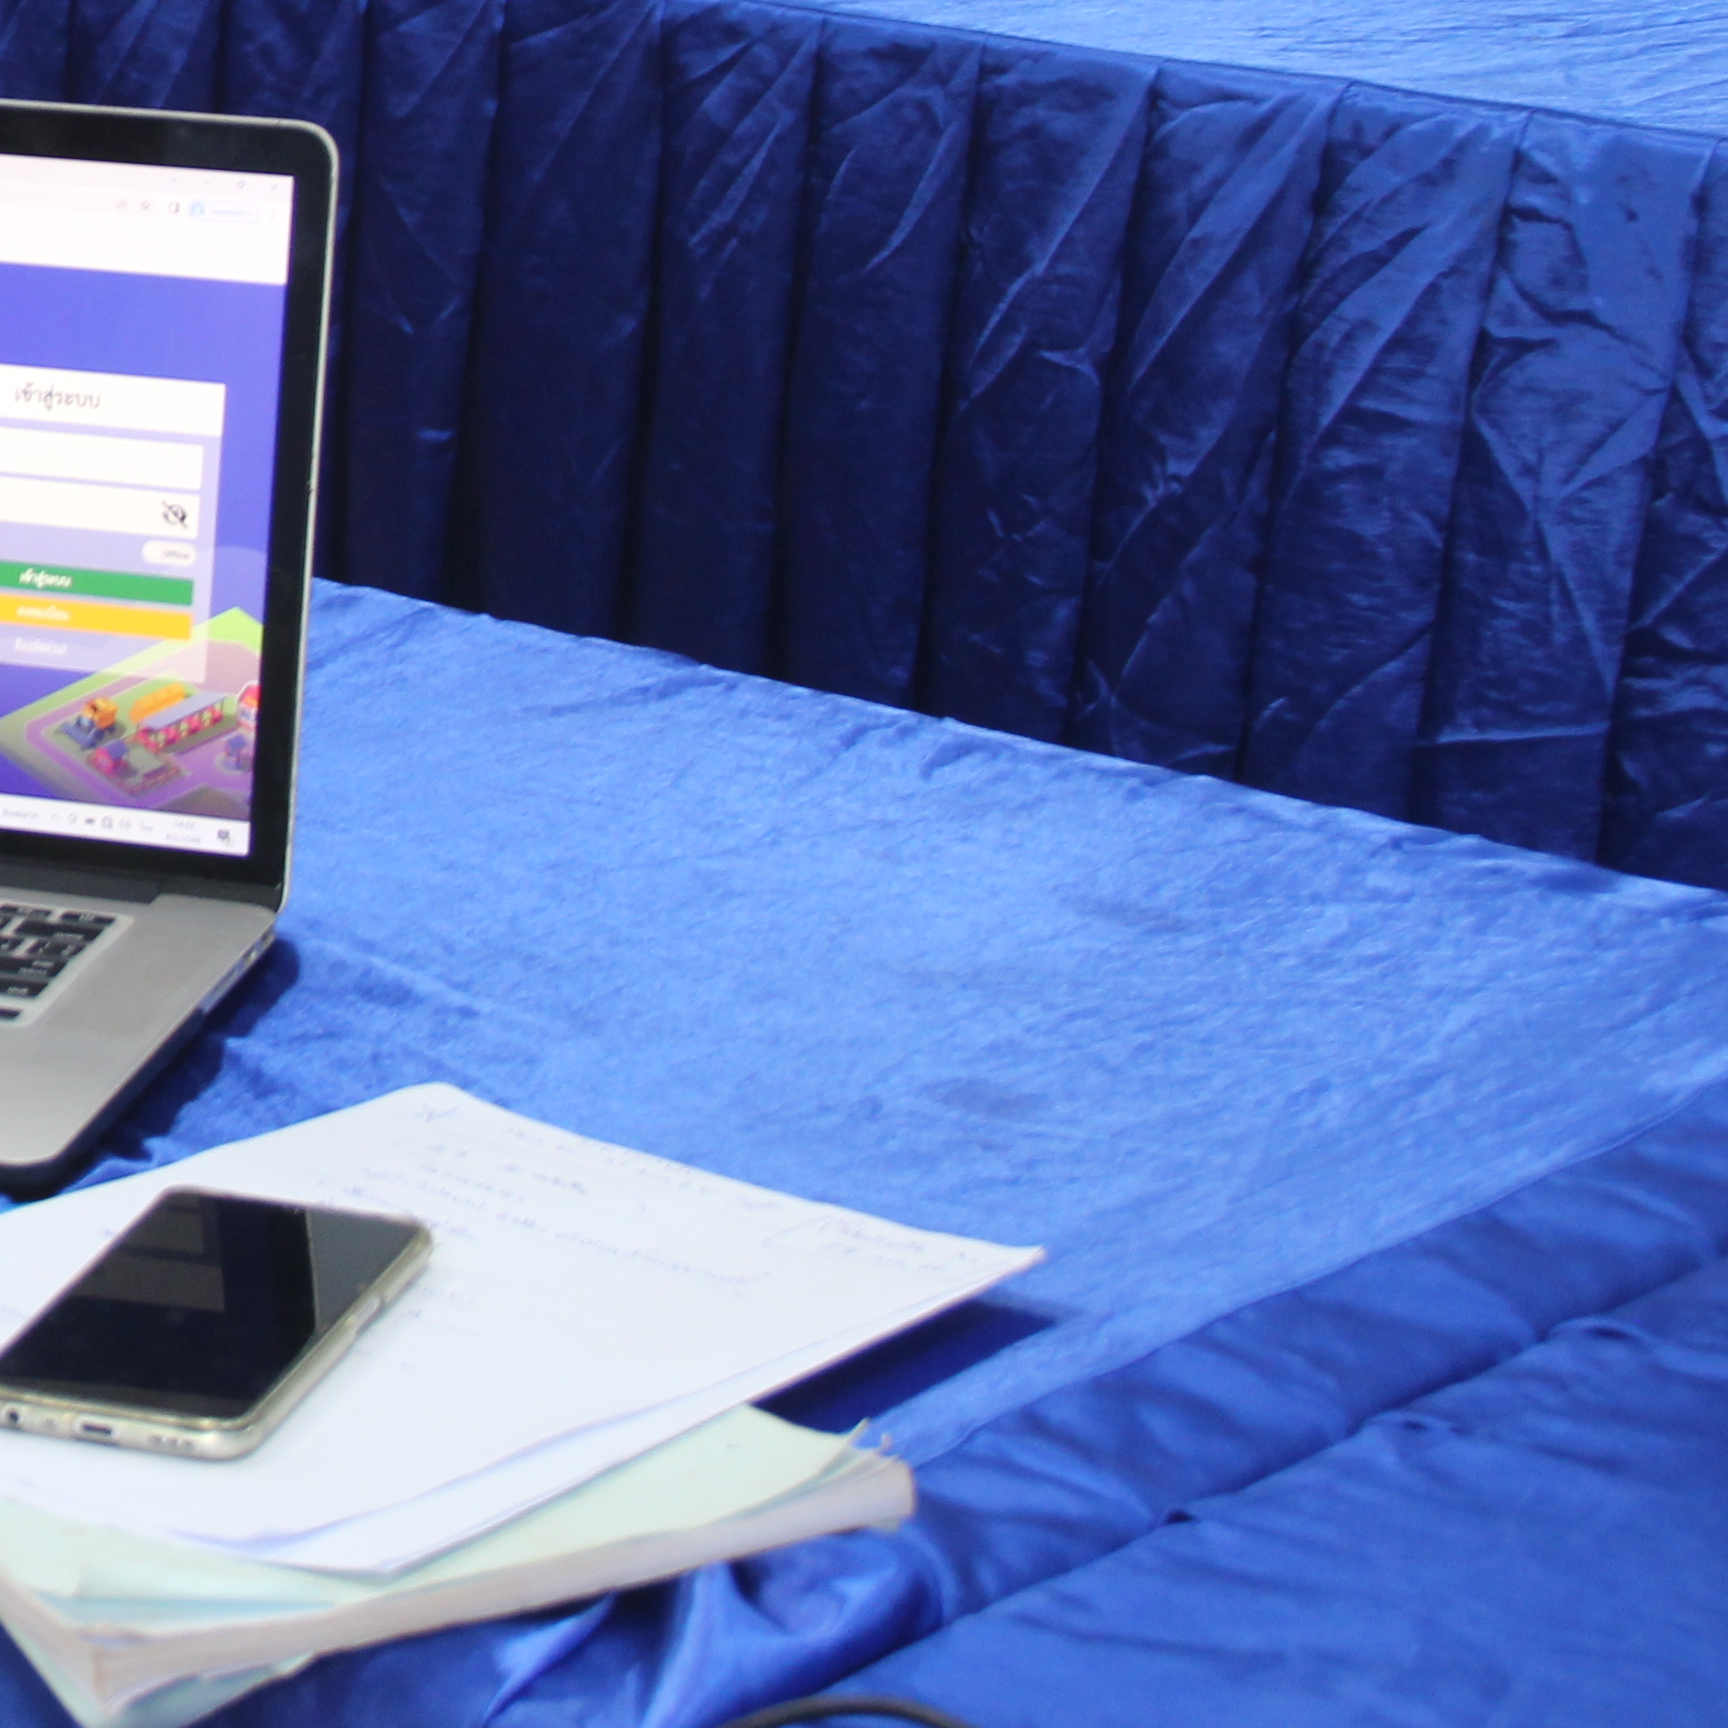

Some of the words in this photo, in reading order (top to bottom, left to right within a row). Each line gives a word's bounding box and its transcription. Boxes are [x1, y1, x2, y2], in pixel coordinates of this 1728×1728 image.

[15, 381, 102, 411] เข้าสู่ระบบ
